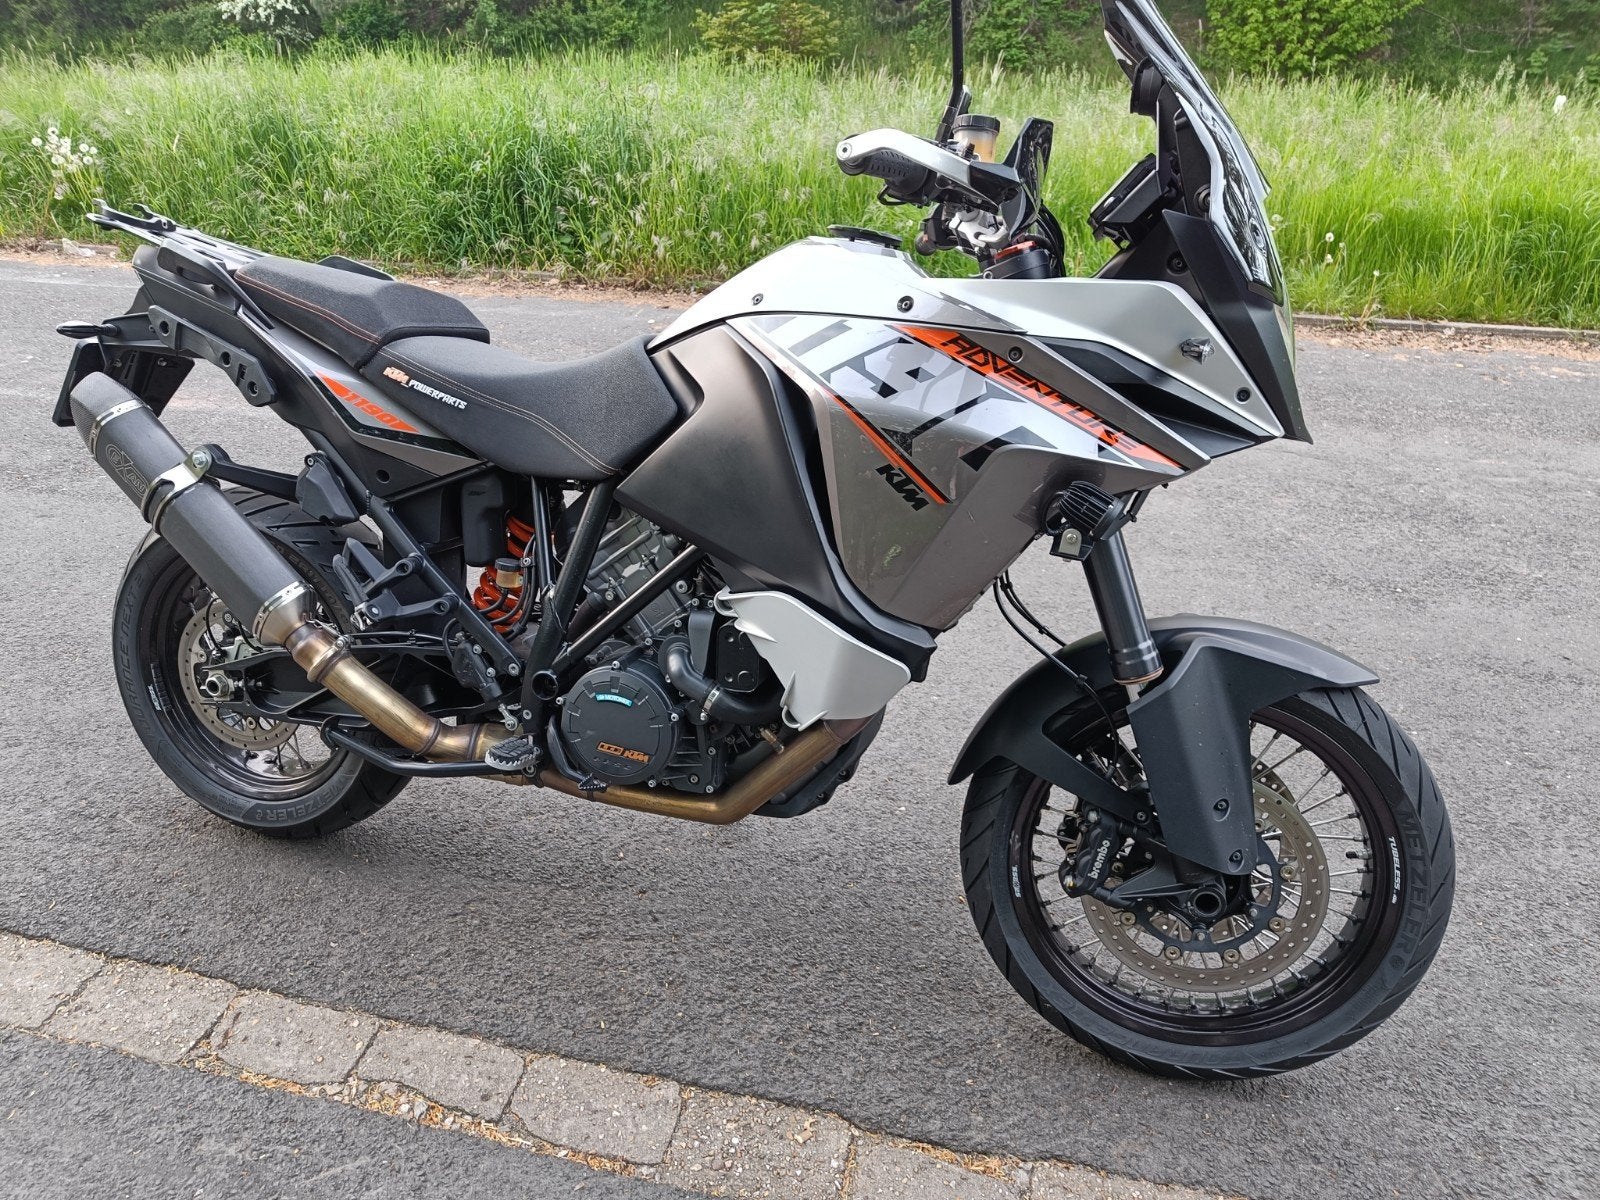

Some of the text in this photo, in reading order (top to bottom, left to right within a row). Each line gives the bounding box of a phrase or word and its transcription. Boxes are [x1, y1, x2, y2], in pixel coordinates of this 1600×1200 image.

[342, 390, 400, 428] 1190
[408, 379, 468, 410] POWERPARTS
[941, 333, 1140, 450] ADVENTURE
[875, 463, 930, 511] KTM
[1088, 839, 1111, 880] brembo
[1388, 836, 1401, 892] TUBELESS
[1397, 811, 1430, 954] METZELER
